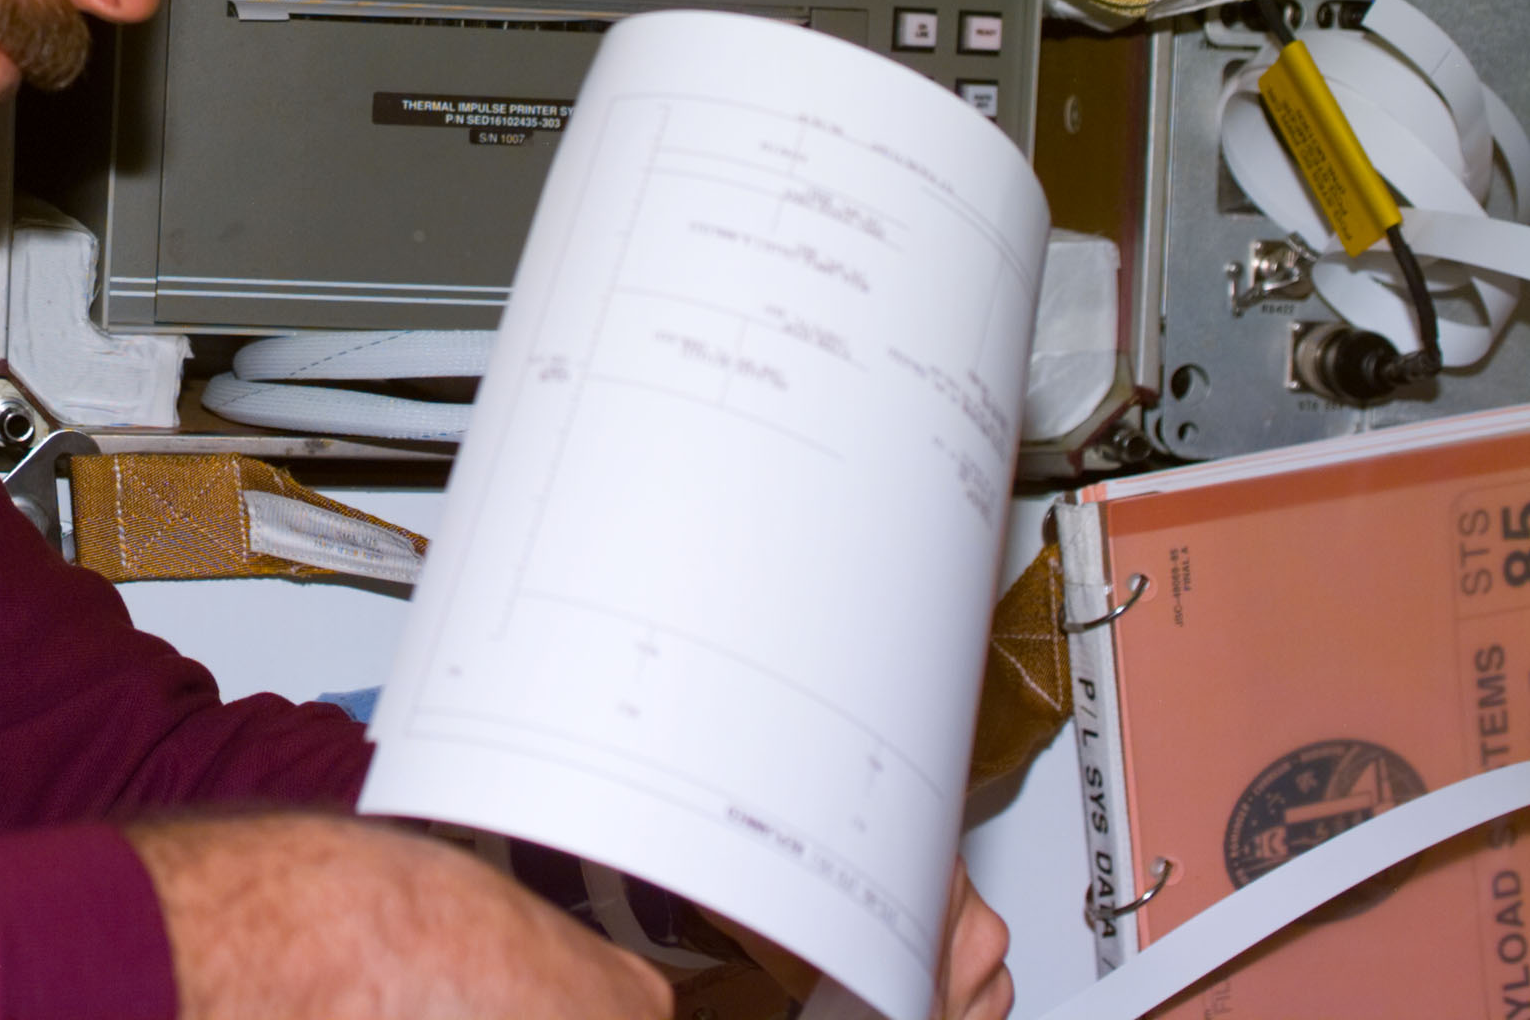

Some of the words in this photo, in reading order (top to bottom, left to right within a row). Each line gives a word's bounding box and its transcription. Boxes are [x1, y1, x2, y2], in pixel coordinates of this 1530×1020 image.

[402, 100, 456, 112] THERMAL
[458, 102, 507, 115] IMPULSE
[509, 104, 558, 116] PRINTER
[559, 106, 575, 117] SY
[466, 114, 561, 129] SED16102435-303
[501, 133, 526, 145] 1007
[1182, 558, 1192, 592] FINAL
[1458, 507, 1493, 597] STS
[1077, 677, 1099, 748] P/L
[1085, 767, 1109, 835] SYS
[1094, 852, 1117, 940] DATA
[1492, 868, 1530, 1020] YLOAD
